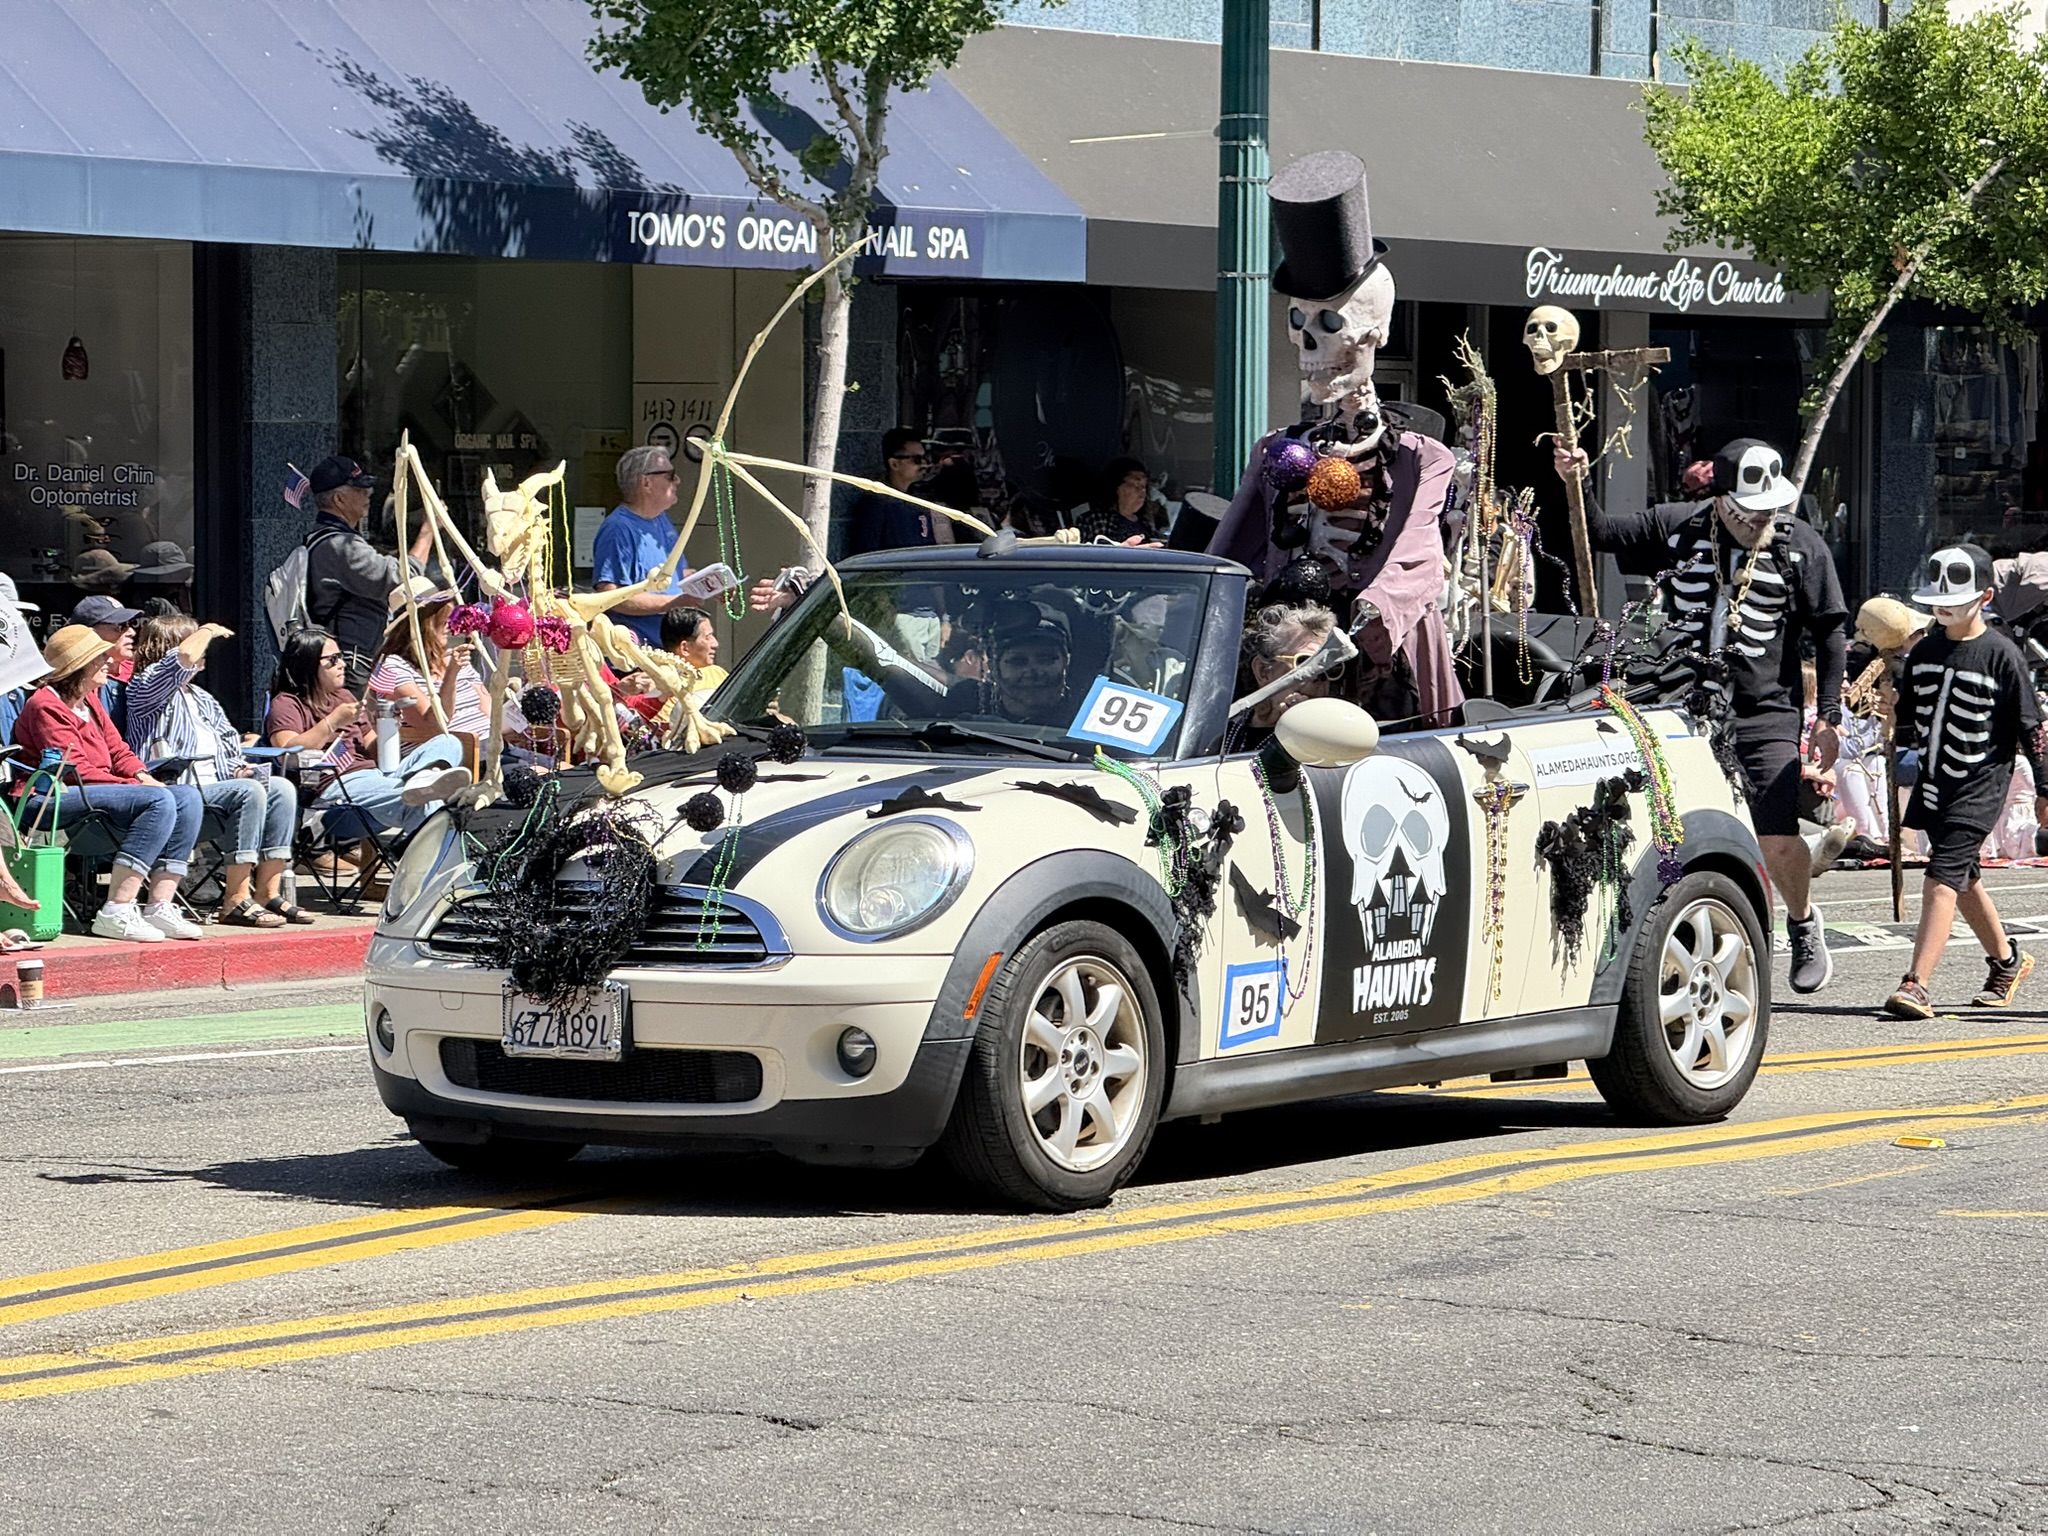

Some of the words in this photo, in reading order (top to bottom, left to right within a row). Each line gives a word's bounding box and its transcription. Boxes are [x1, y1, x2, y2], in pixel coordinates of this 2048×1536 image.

[628, 210, 726, 249] TOMO'S
[737, 217, 834, 255] ORGA
[865, 224, 918, 258] NAIL
[927, 227, 970, 259] SPA
[1526, 247, 1660, 307] Triumphant
[1659, 258, 1705, 312] Life
[1707, 261, 1785, 306] Church
[643, 398, 676, 422] 1413
[681, 399, 712, 422] 1411
[14, 463, 39, 481] Dr.
[48, 464, 105, 483] Daniel
[113, 465, 155, 484] Chin
[30, 486, 139, 508] Optometrist
[1098, 696, 1154, 733] 95
[1536, 750, 1638, 777] ALAMEDAHAUNTS.ORG
[1371, 938, 1423, 962] ALAMEDA
[1352, 957, 1438, 1014] HAUNTS
[1240, 982, 1270, 1027] 95
[1373, 1012, 1388, 1024] EST.
[1390, 1009, 1409, 1022] 2005
